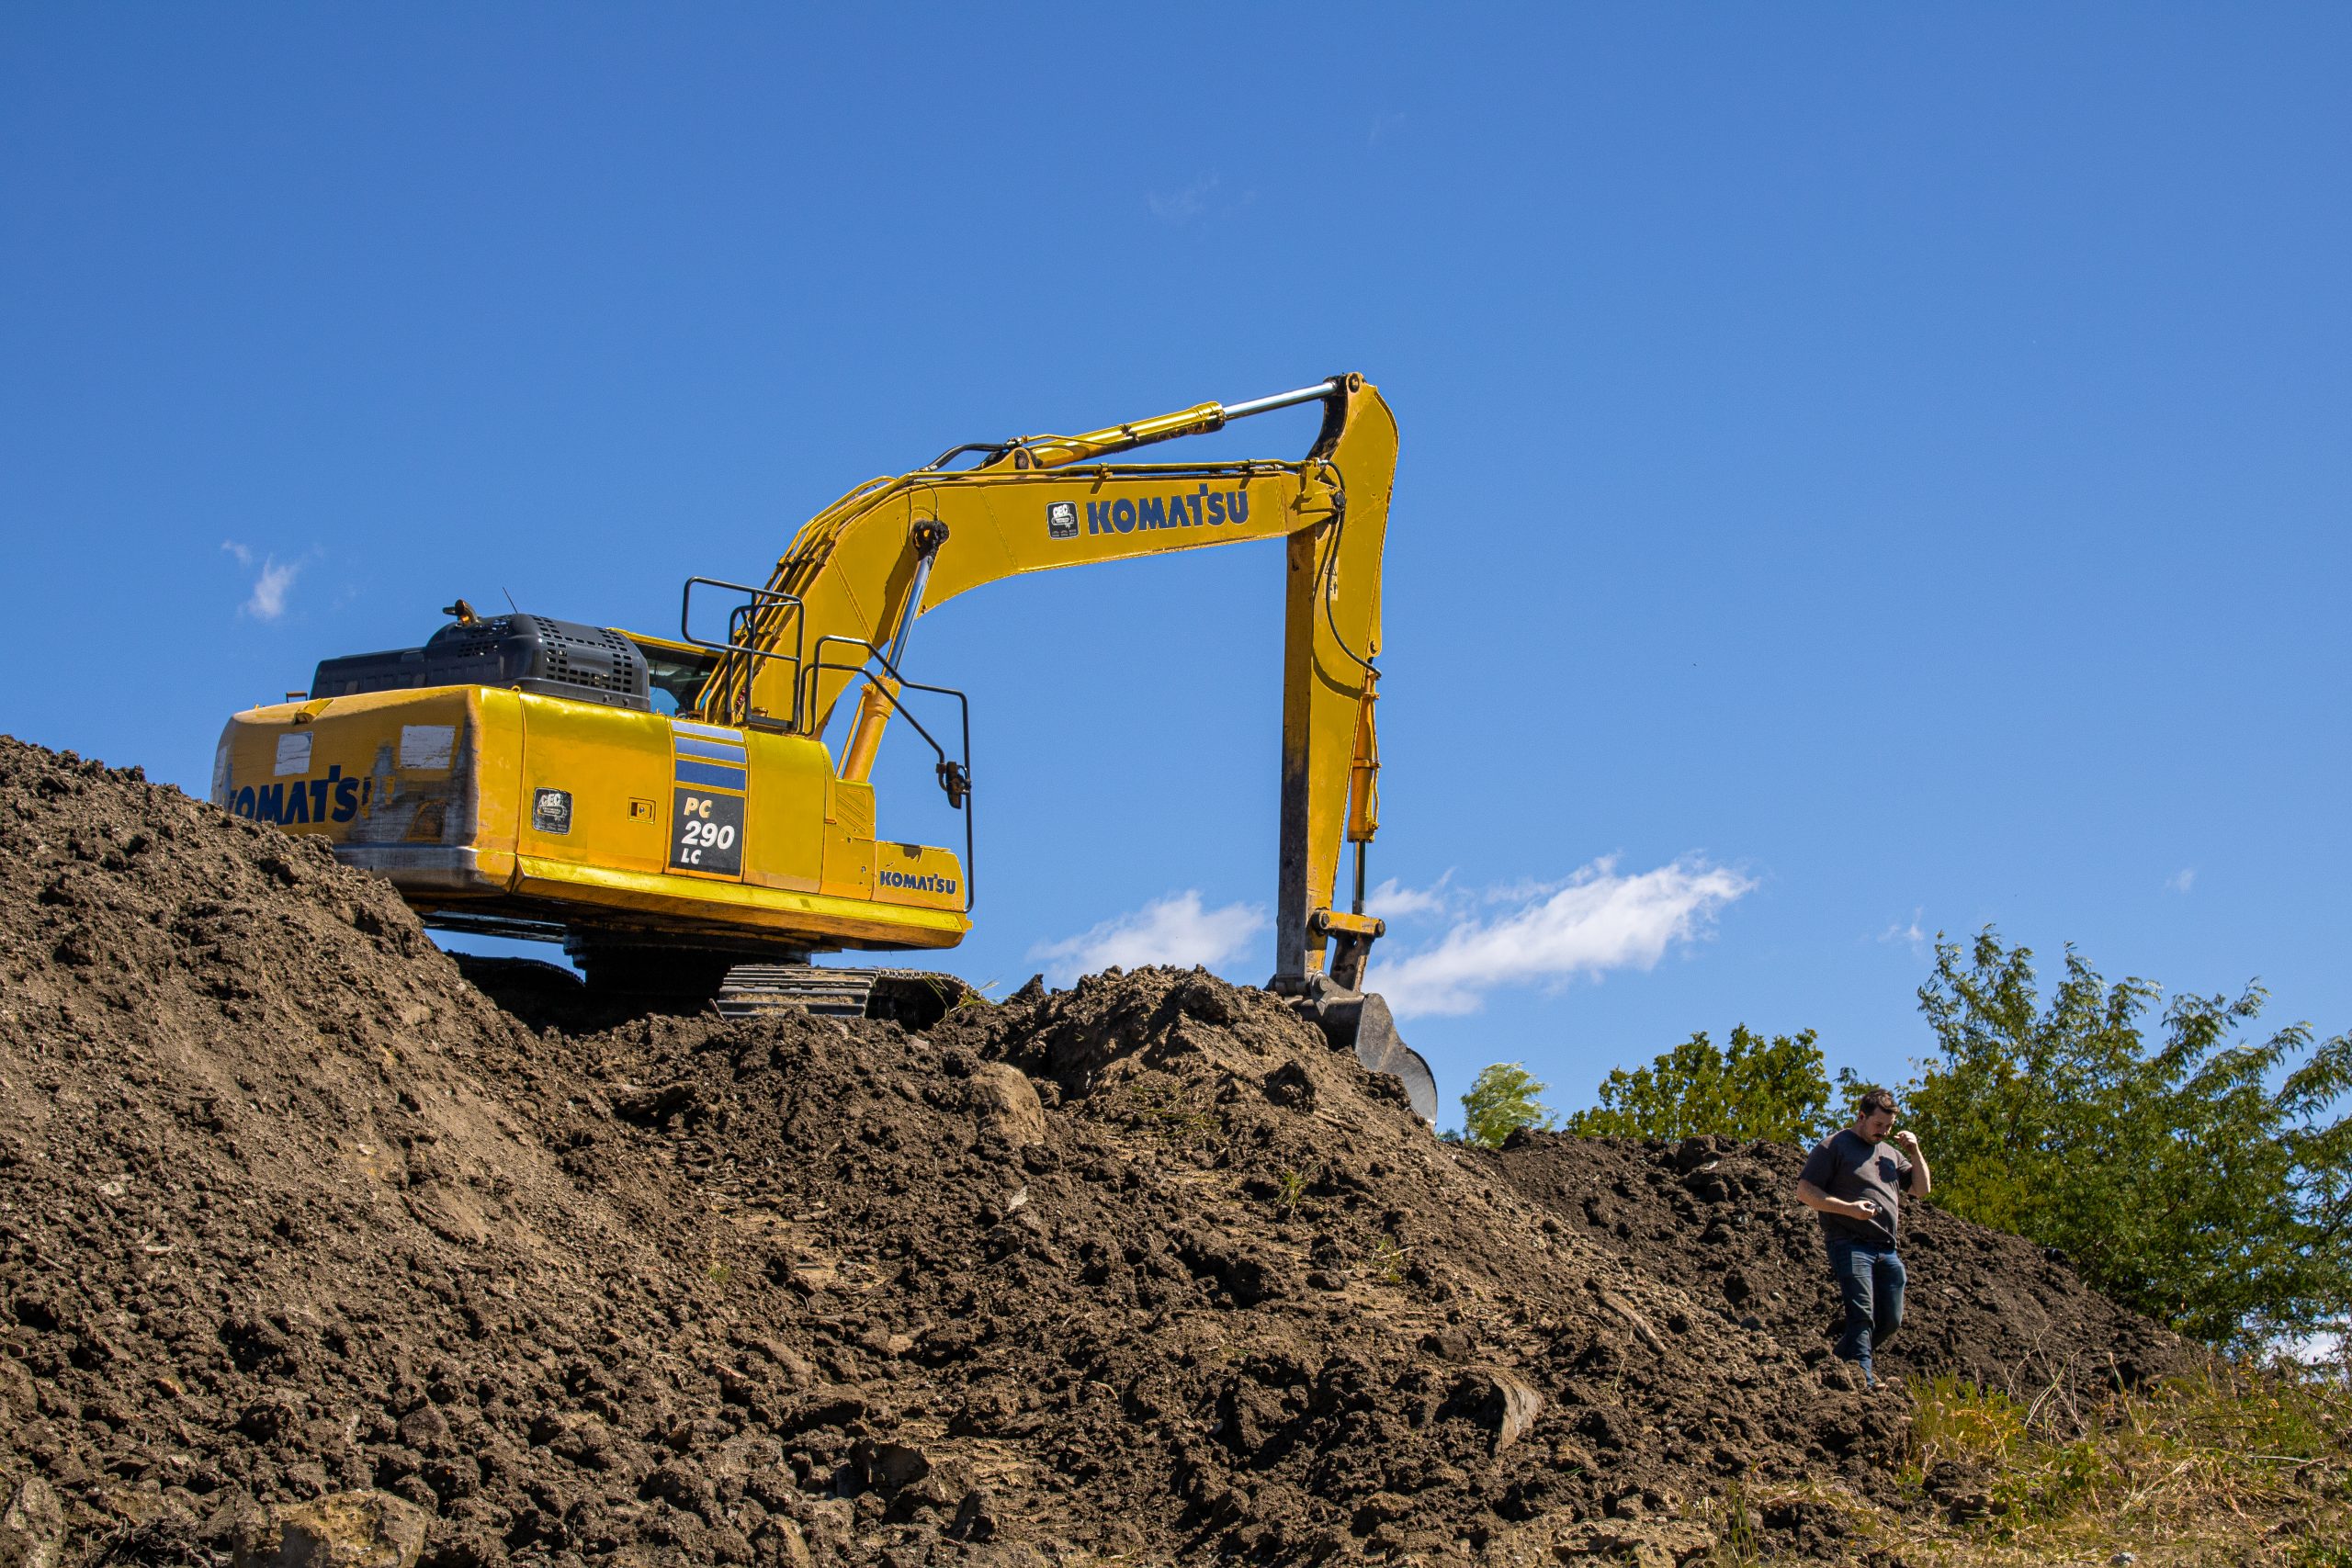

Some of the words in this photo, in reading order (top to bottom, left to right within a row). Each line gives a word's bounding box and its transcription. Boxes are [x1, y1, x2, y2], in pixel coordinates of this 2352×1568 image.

[1086, 483, 1250, 536] KOMATSU
[684, 796, 713, 818] PC
[681, 820, 735, 850] 290
[681, 848, 702, 864] LC
[879, 870, 956, 895] KOMATSU
